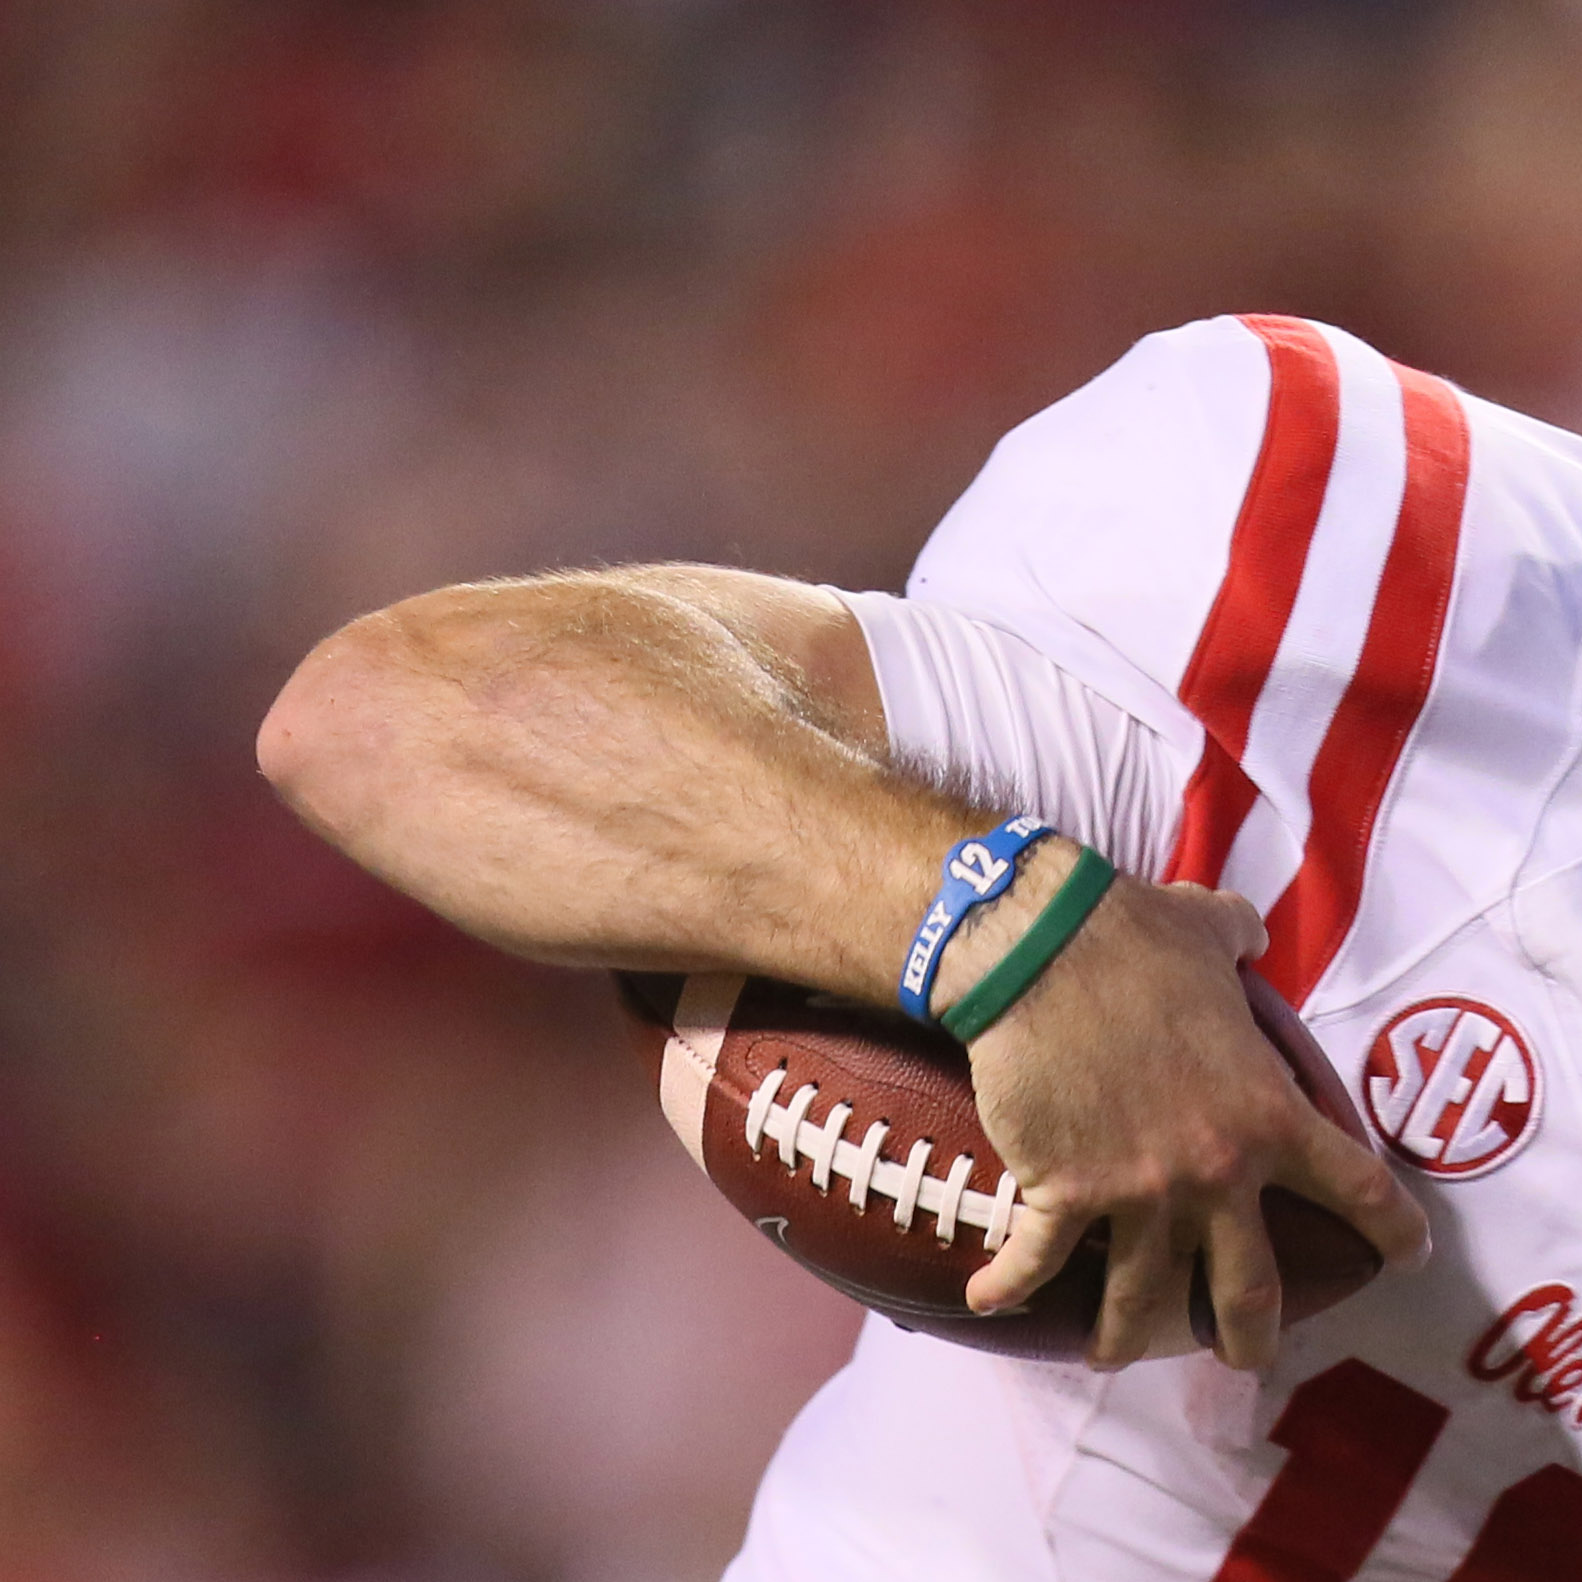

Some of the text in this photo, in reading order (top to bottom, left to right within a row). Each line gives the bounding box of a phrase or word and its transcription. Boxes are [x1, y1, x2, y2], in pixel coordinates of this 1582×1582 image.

[903, 901, 952, 996] KELLY
[950, 841, 1010, 896] 12
[1369, 1007, 1530, 1165] SEC
